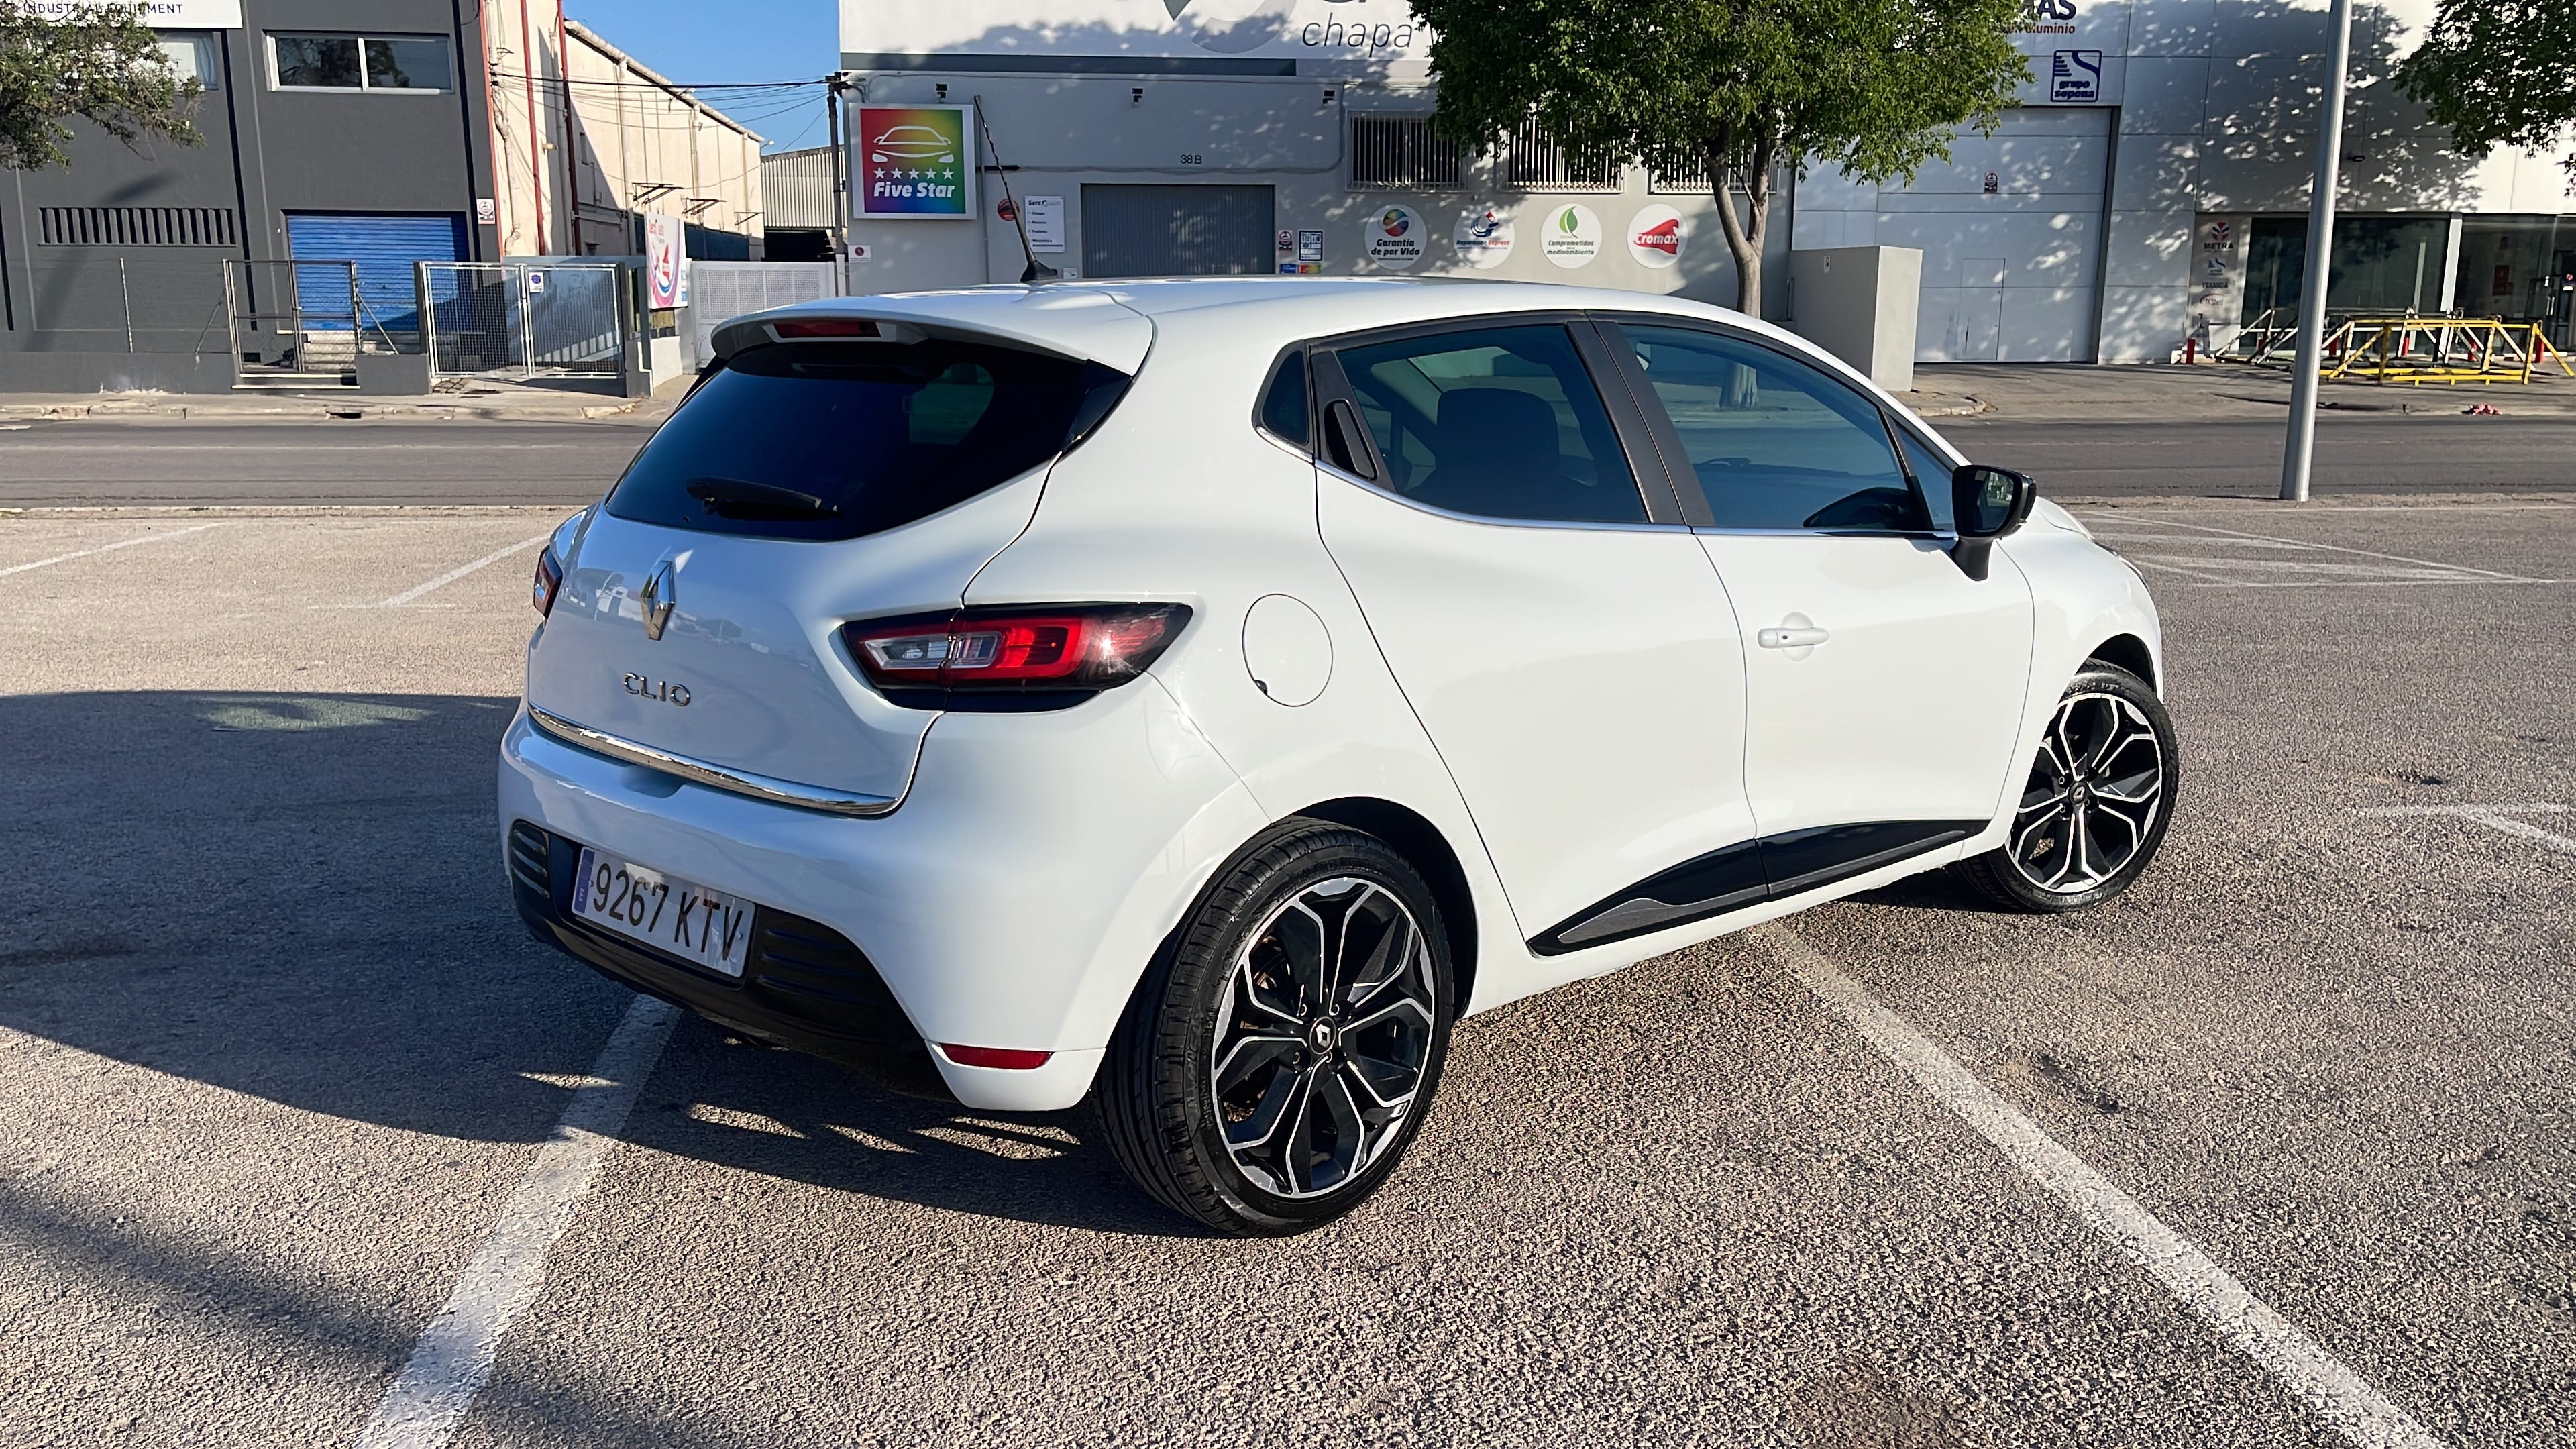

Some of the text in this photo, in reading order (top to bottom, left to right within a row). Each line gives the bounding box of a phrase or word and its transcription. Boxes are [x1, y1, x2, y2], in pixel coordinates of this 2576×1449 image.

[1302, 12, 1412, 58] chapa
[2059, 80, 2090, 89] grupo
[1180, 154, 1202, 164] 38 B
[873, 182, 955, 198] Five Star
[1635, 233, 1678, 244] Cromax
[1371, 247, 1420, 257] de por Vida
[623, 672, 691, 707] CLIO
[594, 863, 743, 961] 9267 KTV
